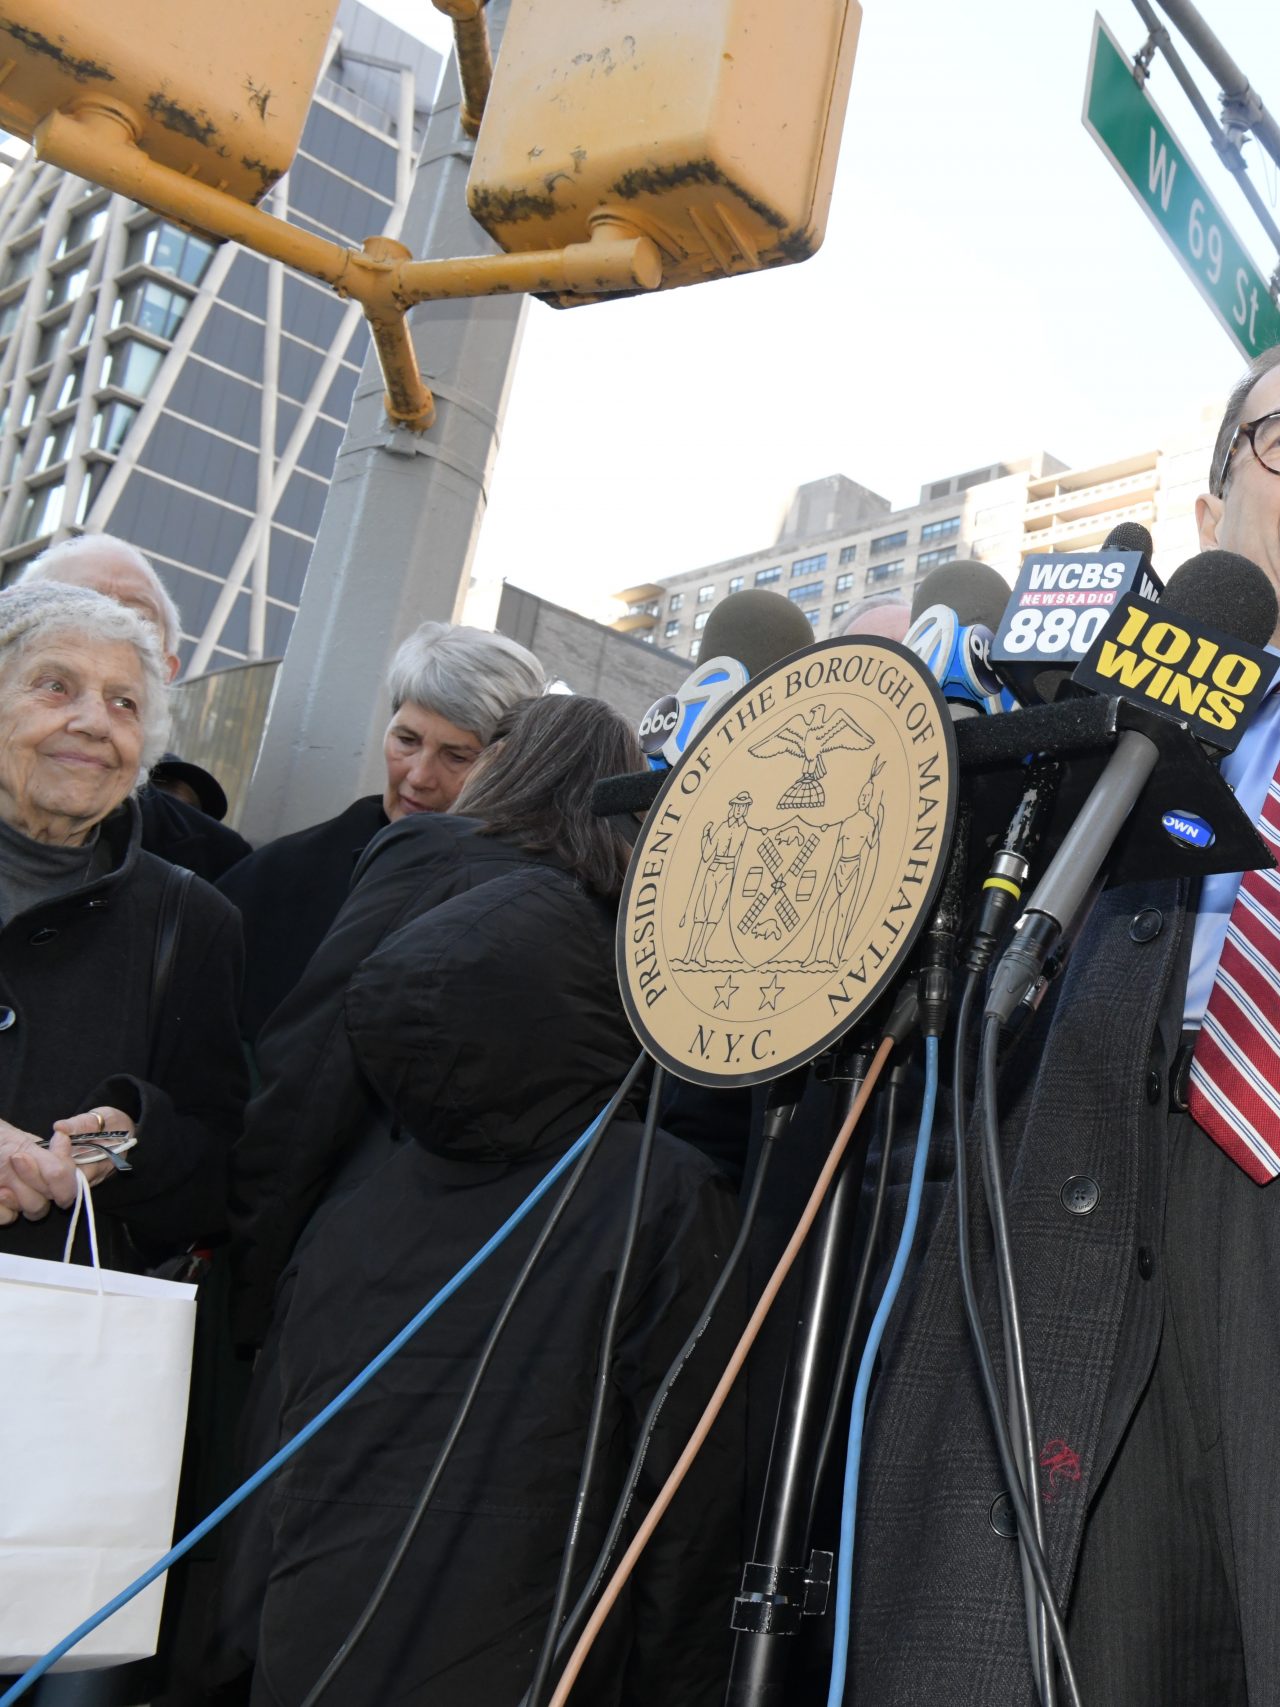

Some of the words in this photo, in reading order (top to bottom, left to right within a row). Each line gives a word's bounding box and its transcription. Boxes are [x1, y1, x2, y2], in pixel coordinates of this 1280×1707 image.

[1149, 127, 1178, 213] W
[1188, 198, 1223, 285] 69
[1233, 268, 1260, 345] St
[1022, 592, 1116, 606] NEWSRADIO
[1028, 562, 1125, 590] WCBS
[1003, 607, 1110, 654] 880
[1116, 605, 1262, 696] 1010
[784, 655, 914, 710] BOROUGH
[1096, 640, 1245, 731] WINS
[640, 709, 678, 735] abc
[717, 686, 776, 744] THE
[906, 702, 935, 745] OF
[681, 746, 712, 796] OF
[634, 804, 683, 1010] PRESIDENT
[827, 751, 942, 1017] MANHATTAN
